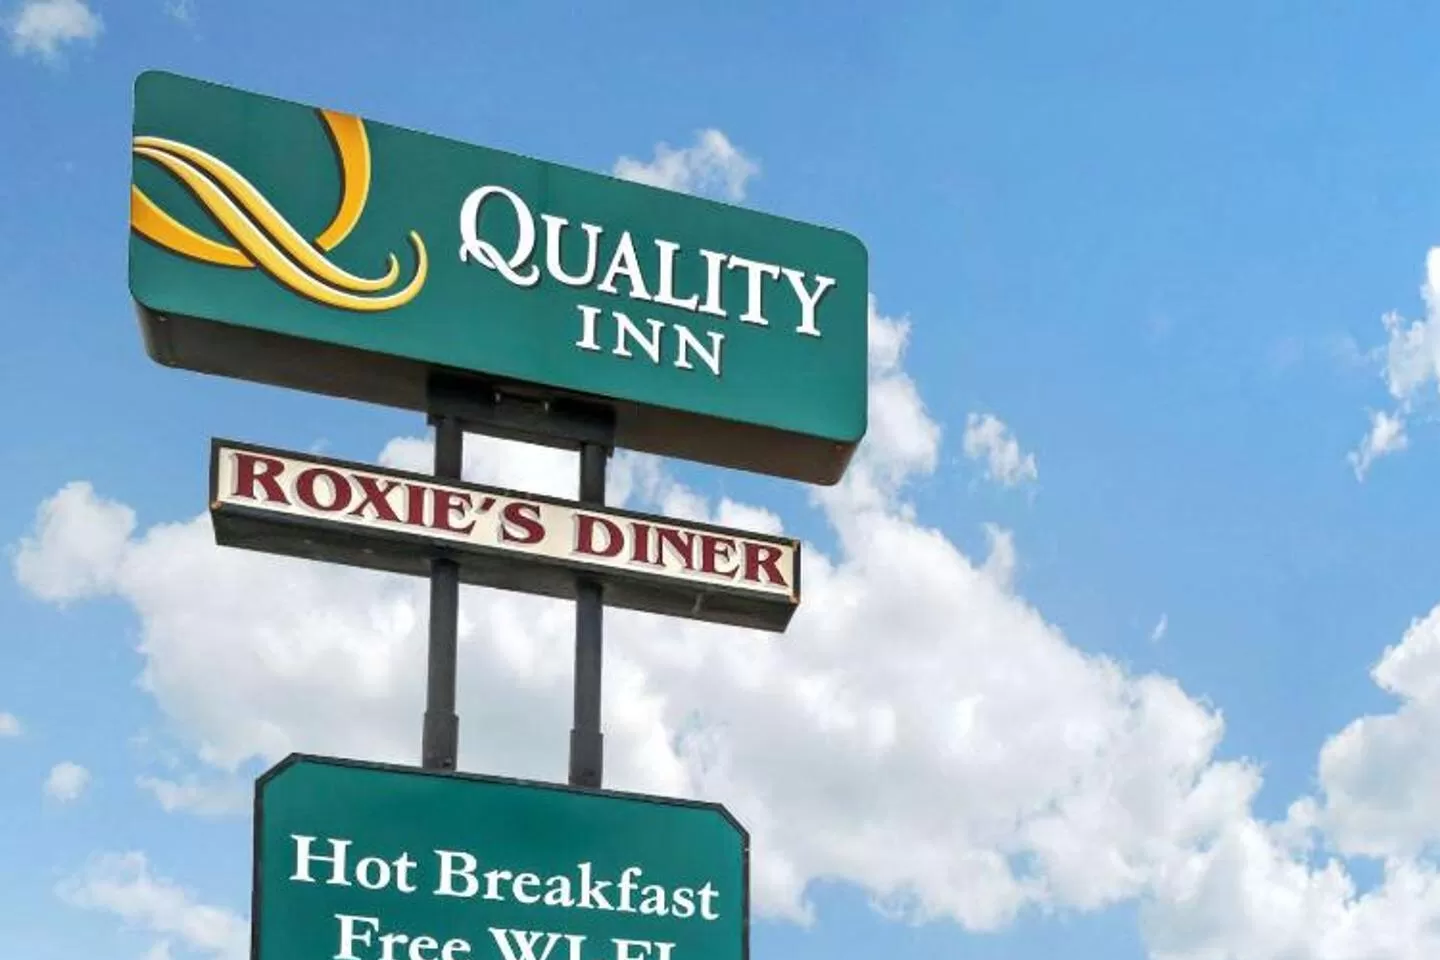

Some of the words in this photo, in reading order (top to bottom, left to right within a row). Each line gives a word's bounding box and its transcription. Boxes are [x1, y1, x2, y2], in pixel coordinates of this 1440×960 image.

[459, 185, 837, 337] QUALITY
[575, 304, 725, 376] INN
[232, 452, 546, 544] ROXIE'S
[574, 513, 789, 587] DINER
[289, 834, 417, 888] Hot
[433, 849, 719, 920] Breakfast
